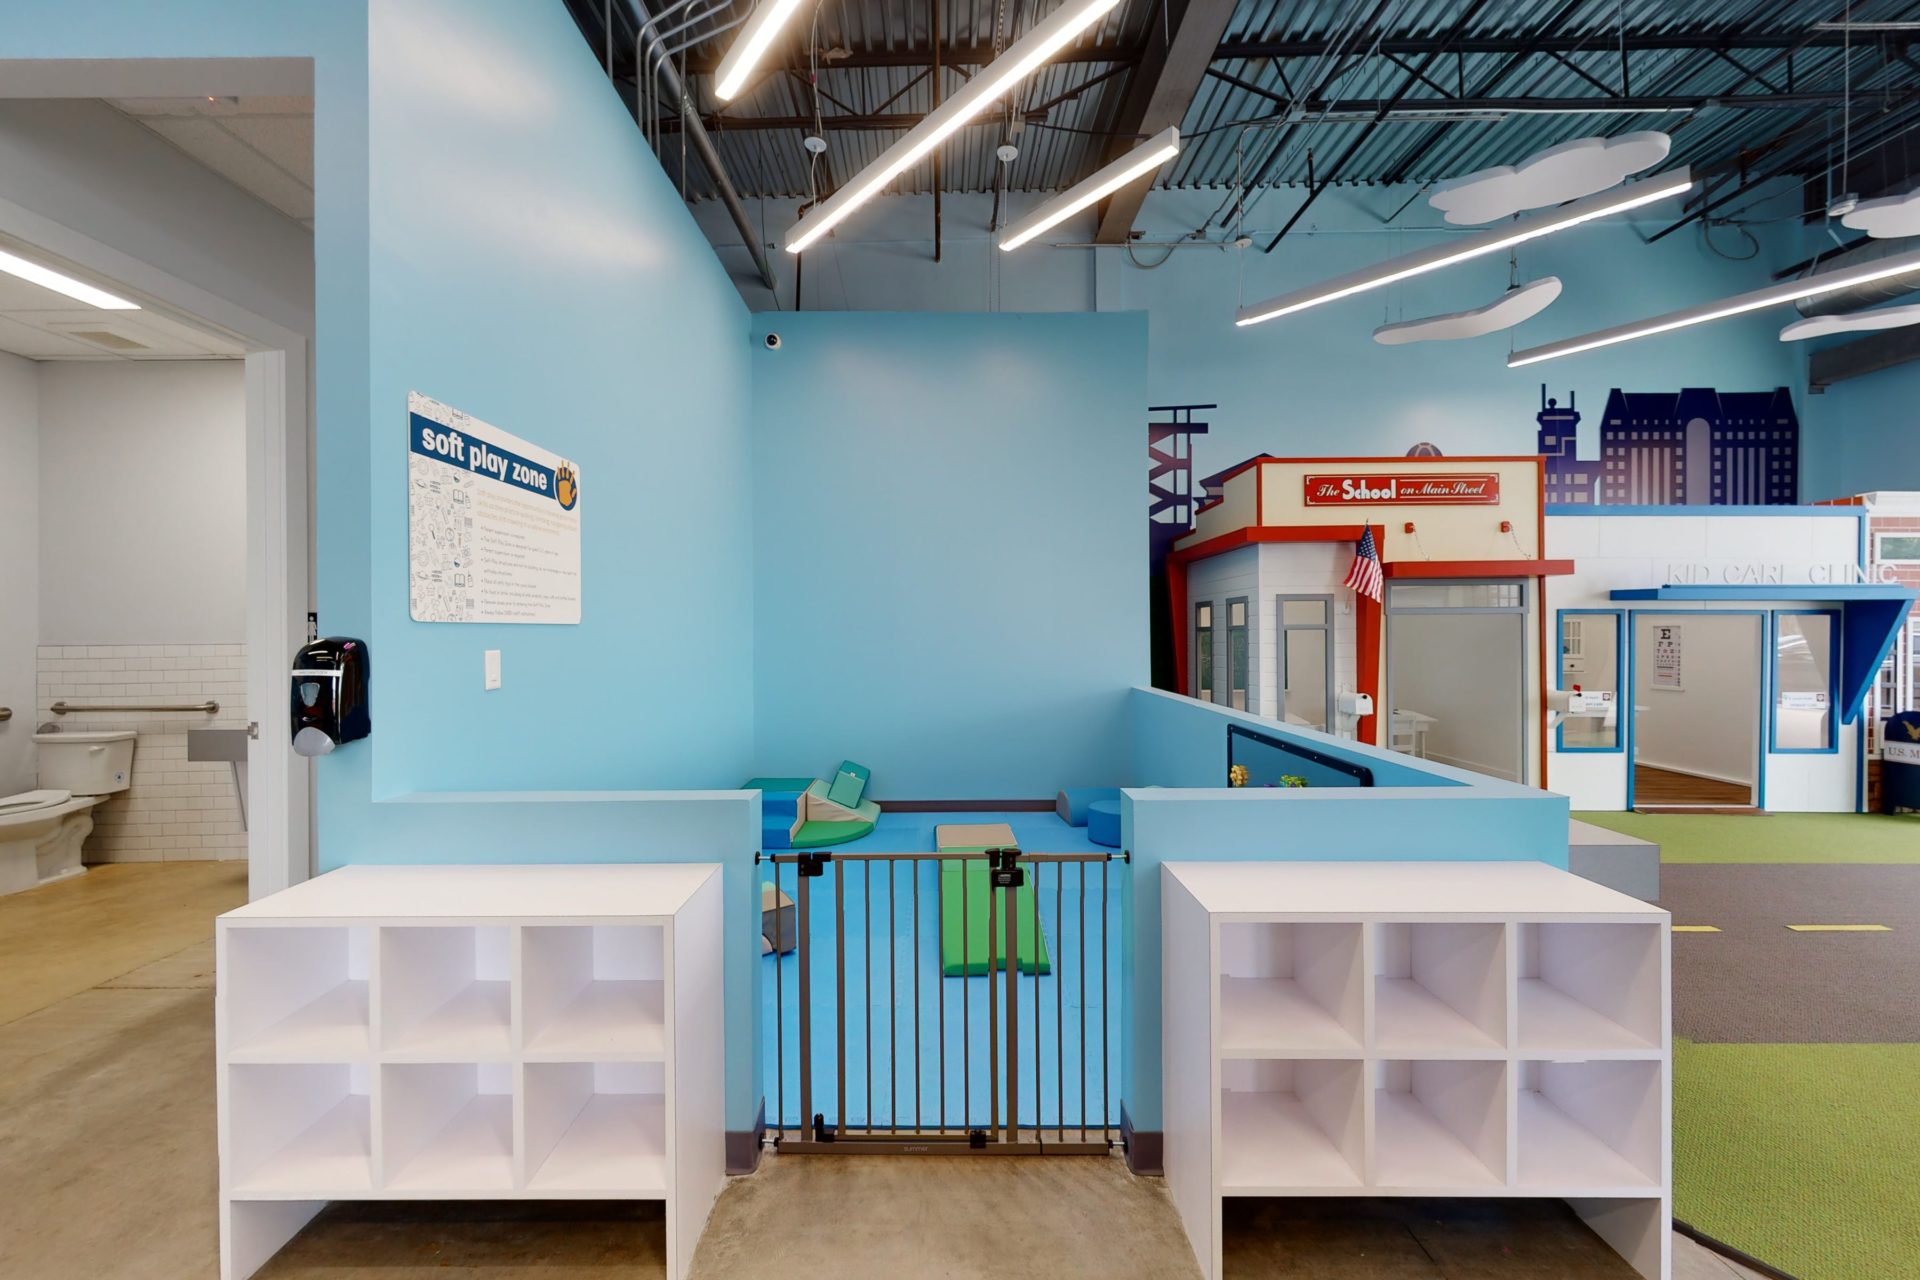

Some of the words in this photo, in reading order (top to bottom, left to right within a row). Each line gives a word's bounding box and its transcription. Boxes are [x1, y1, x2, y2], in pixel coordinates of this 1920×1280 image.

[422, 427, 465, 462] soft
[469, 444, 509, 482] play
[512, 462, 548, 491] zone
[1316, 484, 1340, 497] The
[1342, 479, 1397, 500] School
[1400, 487, 1414, 495] on
[1415, 482, 1450, 495] Main
[1450, 482, 1485, 496] Street
[1667, 563, 1710, 584] KID
[1660, 628, 1671, 640] E
